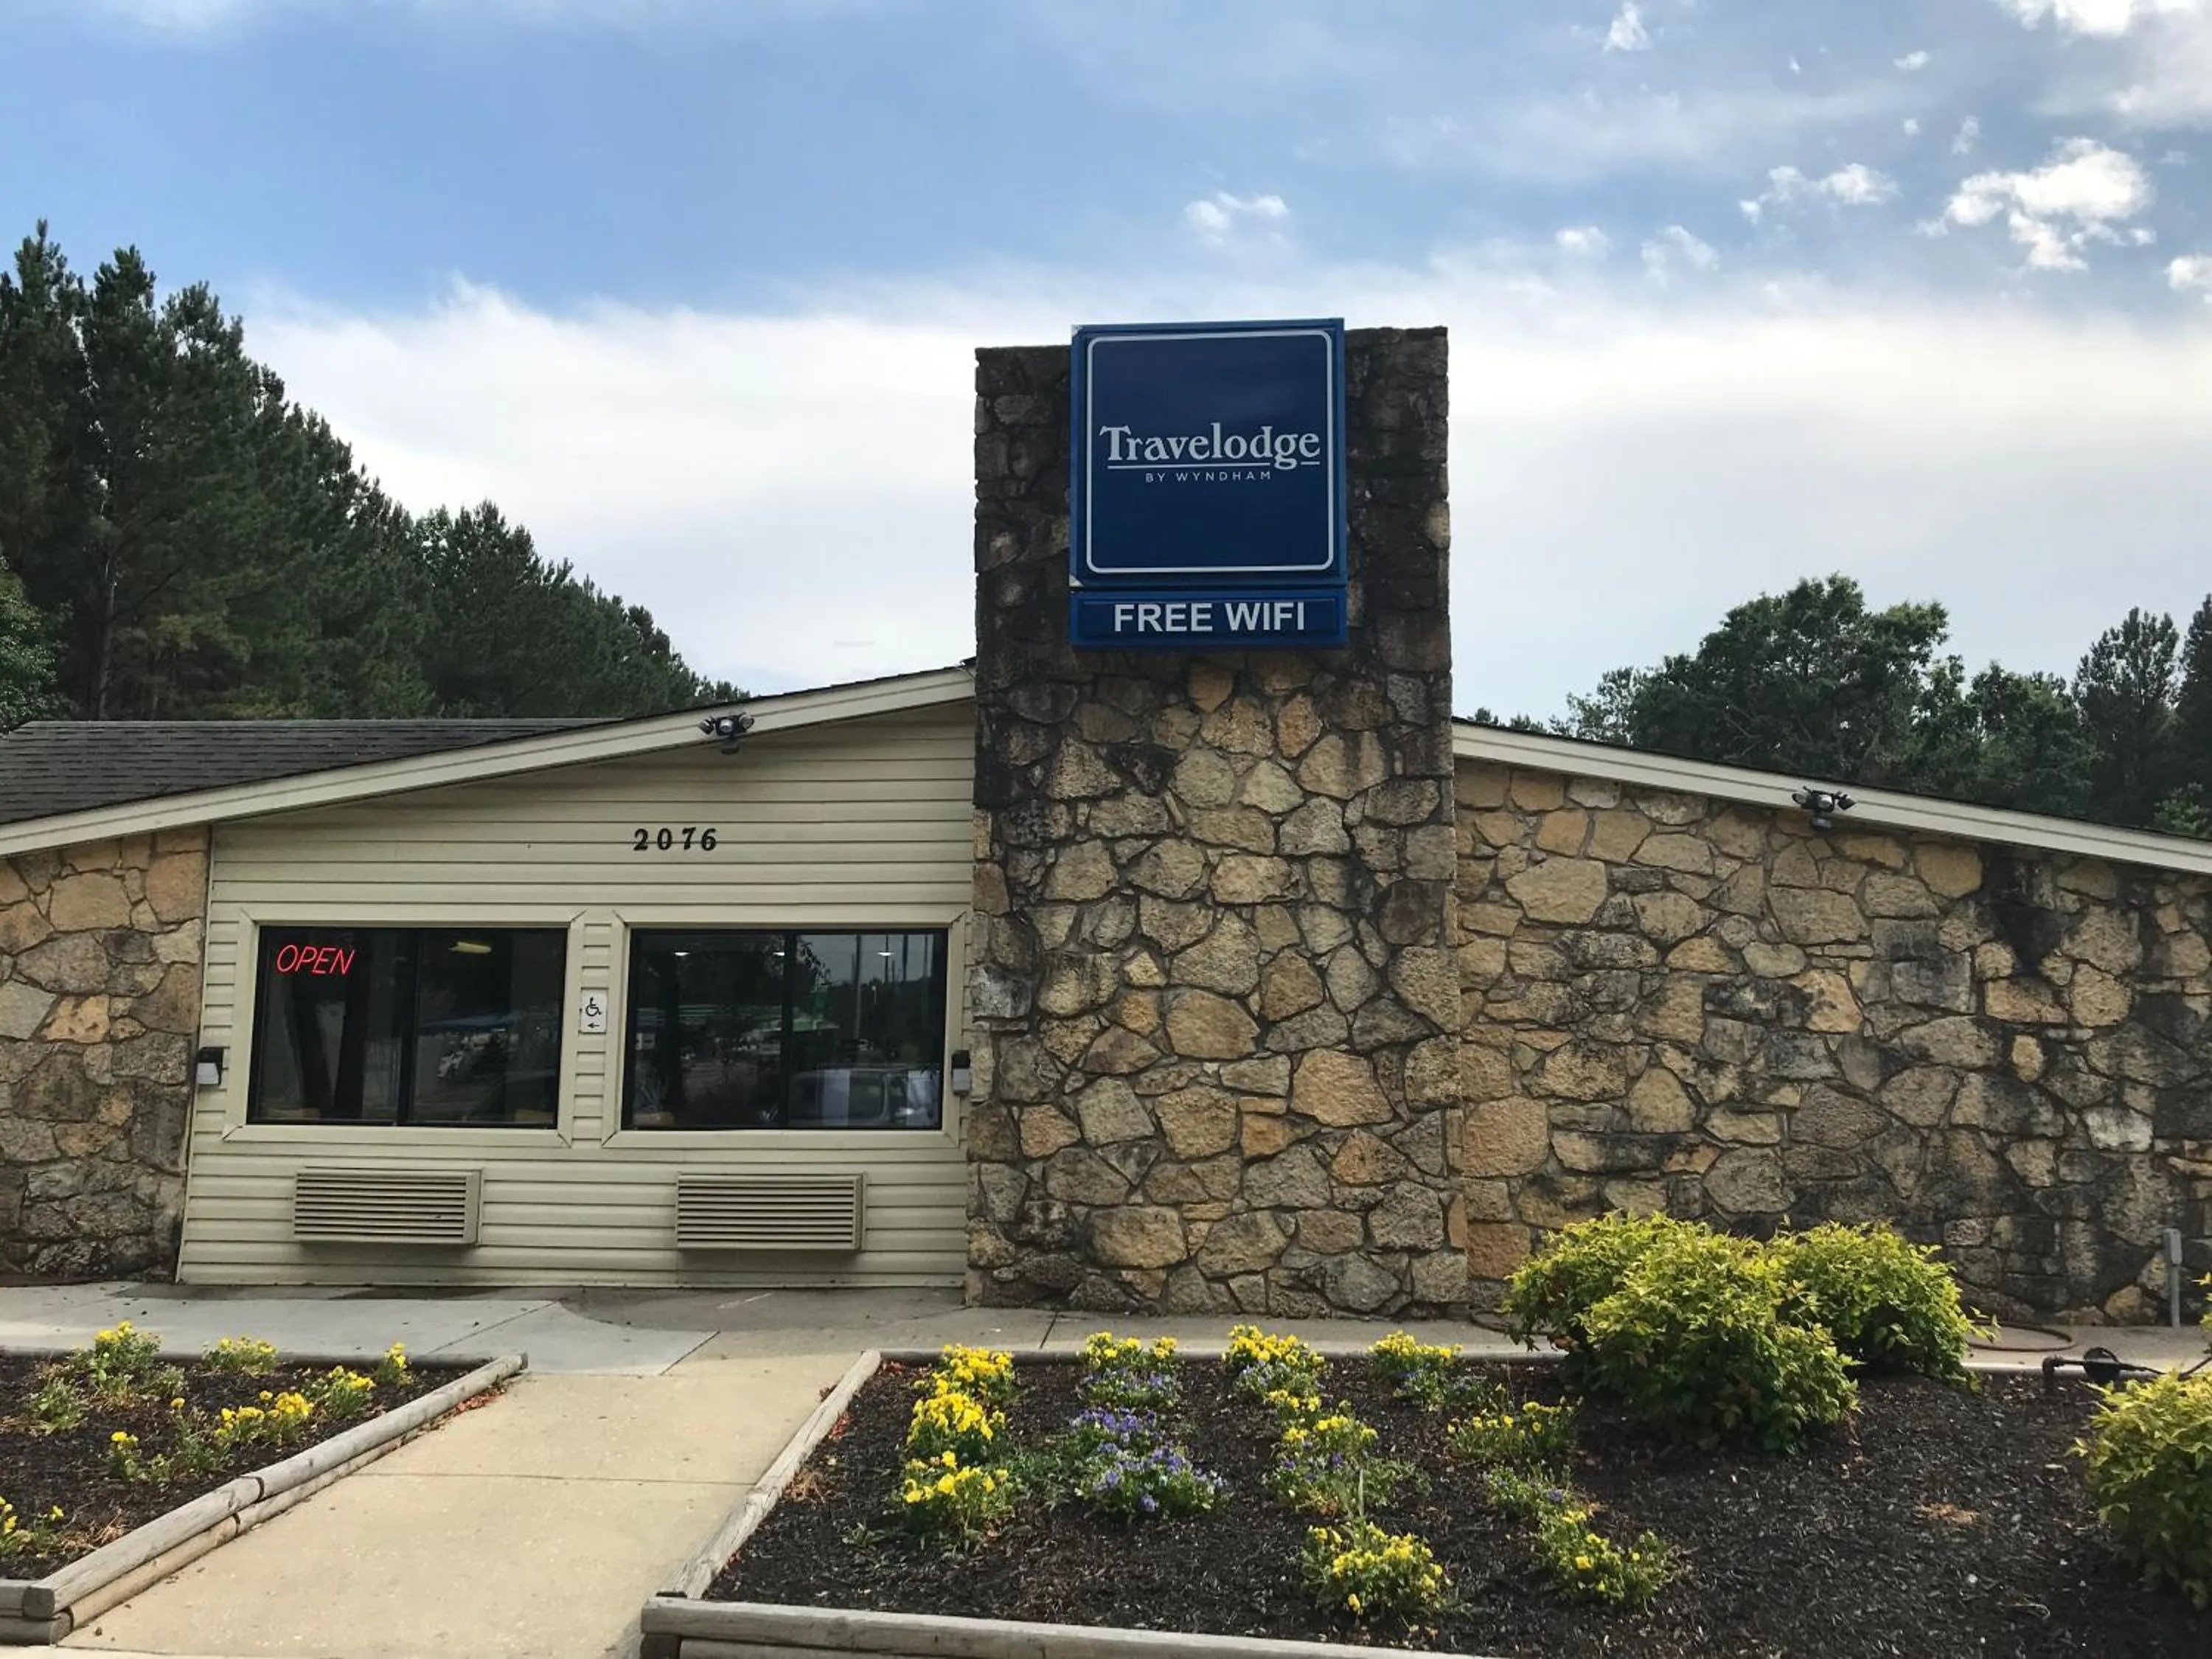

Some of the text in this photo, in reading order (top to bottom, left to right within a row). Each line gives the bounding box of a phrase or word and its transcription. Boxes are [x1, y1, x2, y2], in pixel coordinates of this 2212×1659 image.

[1099, 422, 1321, 470] Travelodge
[1144, 470, 1271, 483] BY WYNDHAM
[1114, 601, 1304, 632] FREE WIFI
[633, 827, 717, 852] 2076
[276, 944, 355, 975] OPEN
